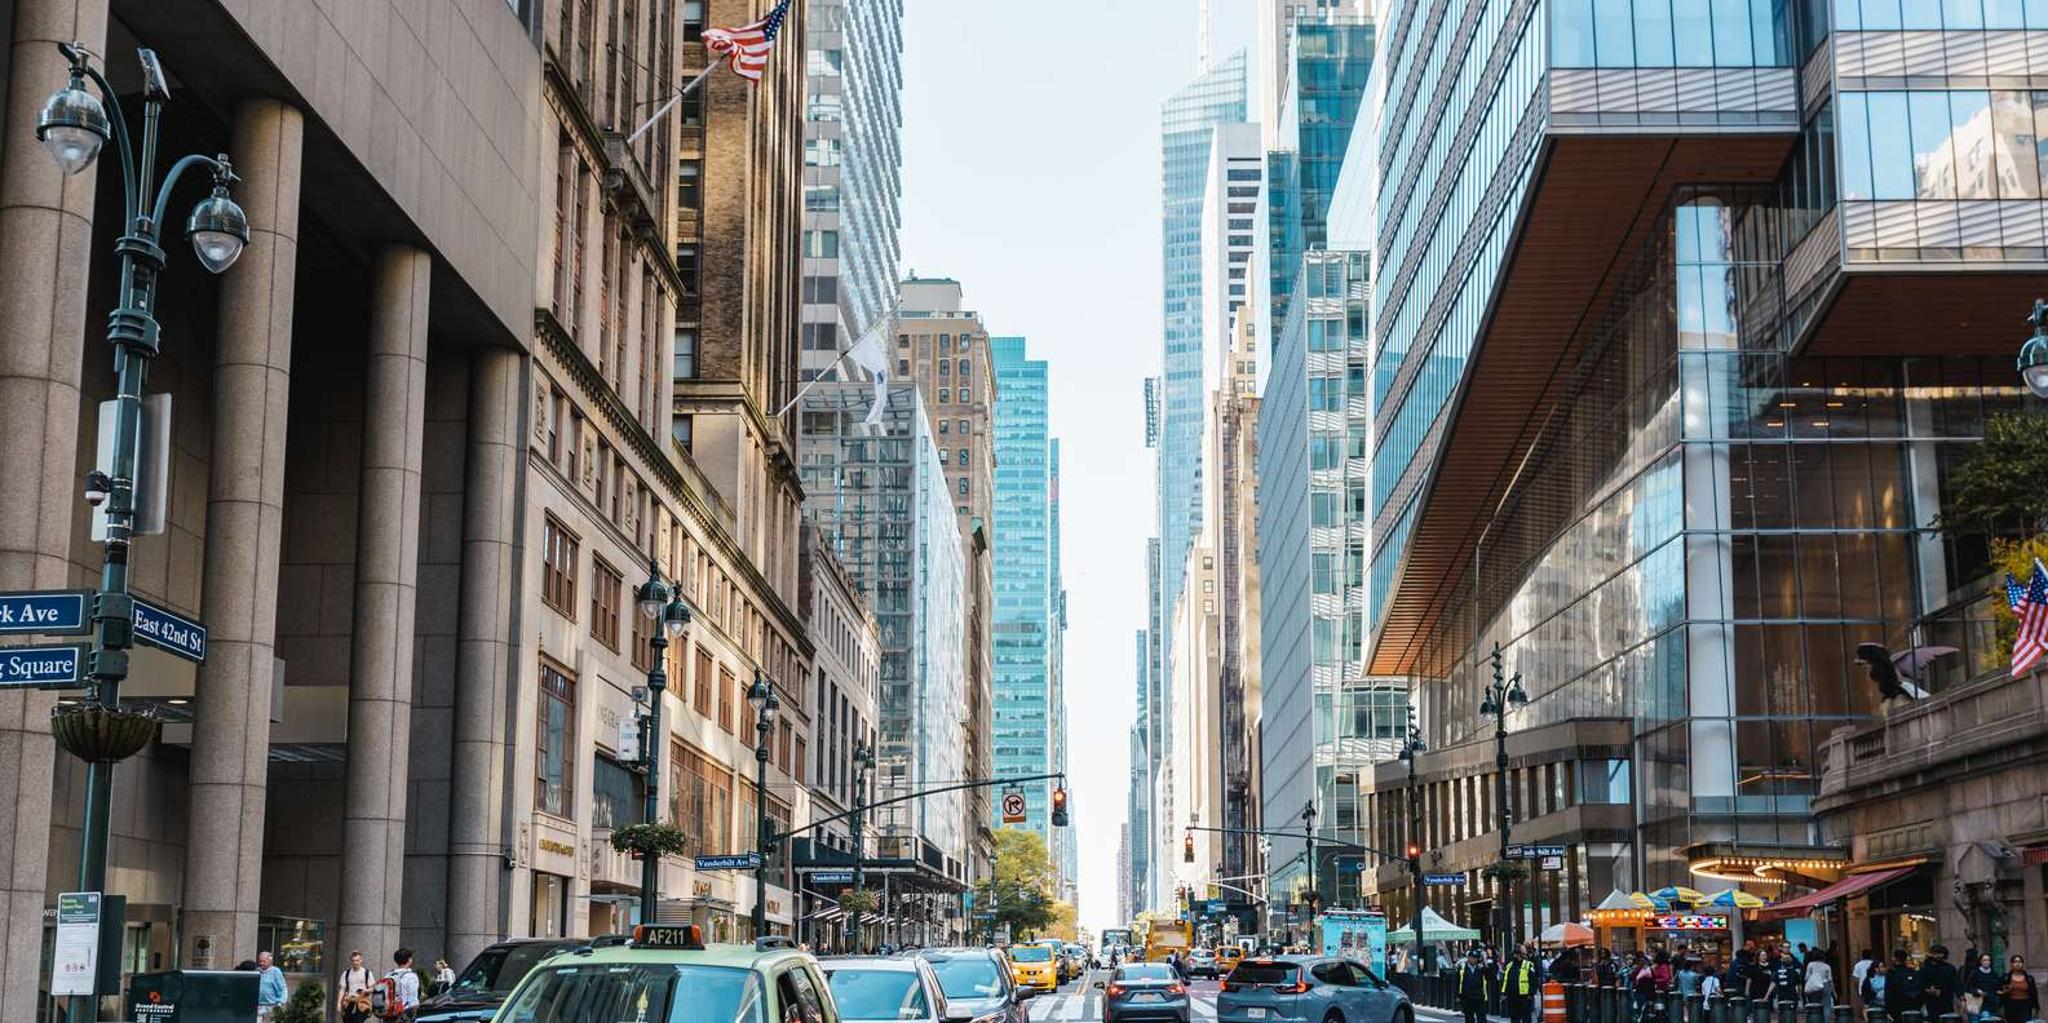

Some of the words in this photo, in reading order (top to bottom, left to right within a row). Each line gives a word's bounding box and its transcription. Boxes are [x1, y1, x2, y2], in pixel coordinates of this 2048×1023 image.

[19, 604, 59, 622] Ave
[135, 609, 159, 635] East
[162, 622, 188, 646] 42nd
[190, 632, 201, 652] St
[9, 656, 73, 678] Square
[698, 859, 735, 867] Vanderbilt
[648, 929, 684, 945] AF211
